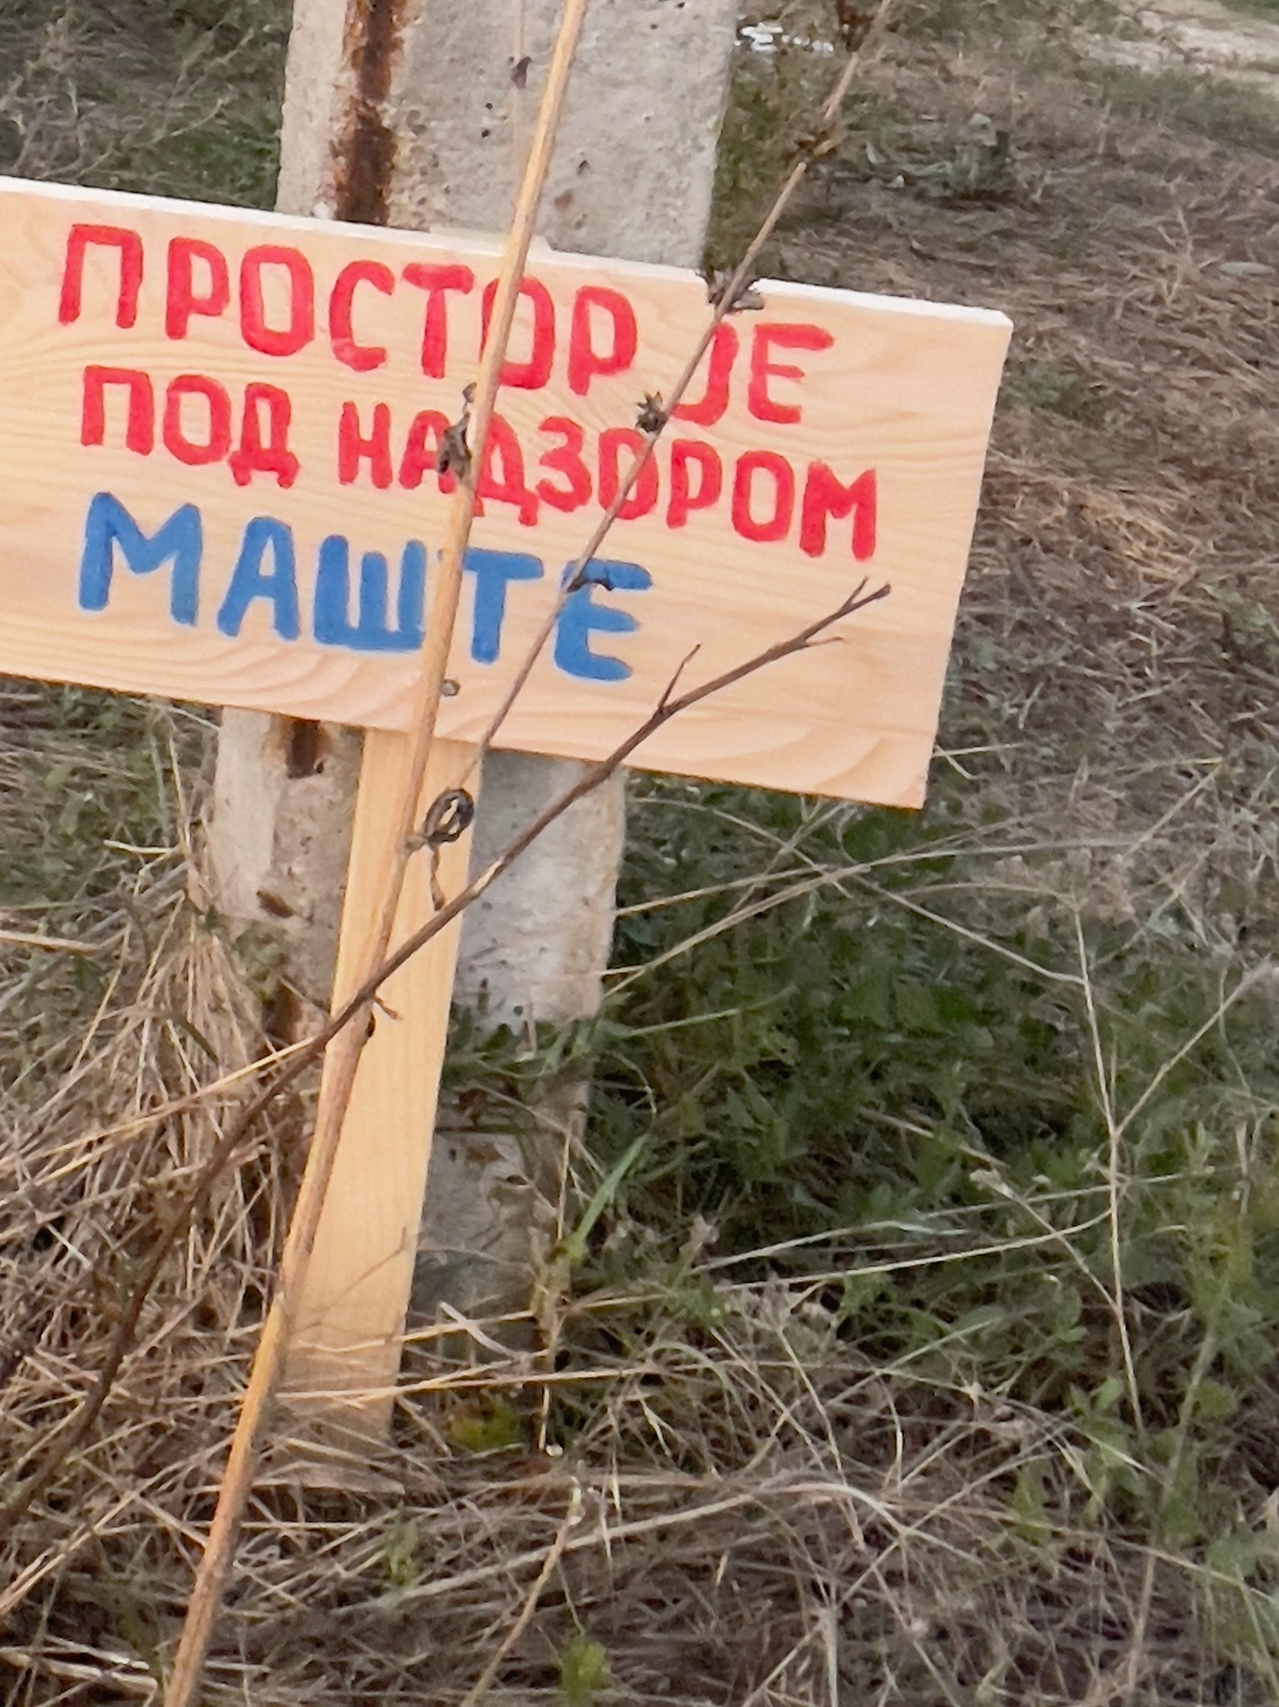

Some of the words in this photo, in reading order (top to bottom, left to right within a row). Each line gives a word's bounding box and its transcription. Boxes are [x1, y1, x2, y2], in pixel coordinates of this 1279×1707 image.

[58, 223, 639, 397] ПРОСТОР
[80, 364, 301, 490] ПОД
[338, 400, 878, 562] НАДЗОРОМ
[78, 491, 652, 682] МАШТЕ
